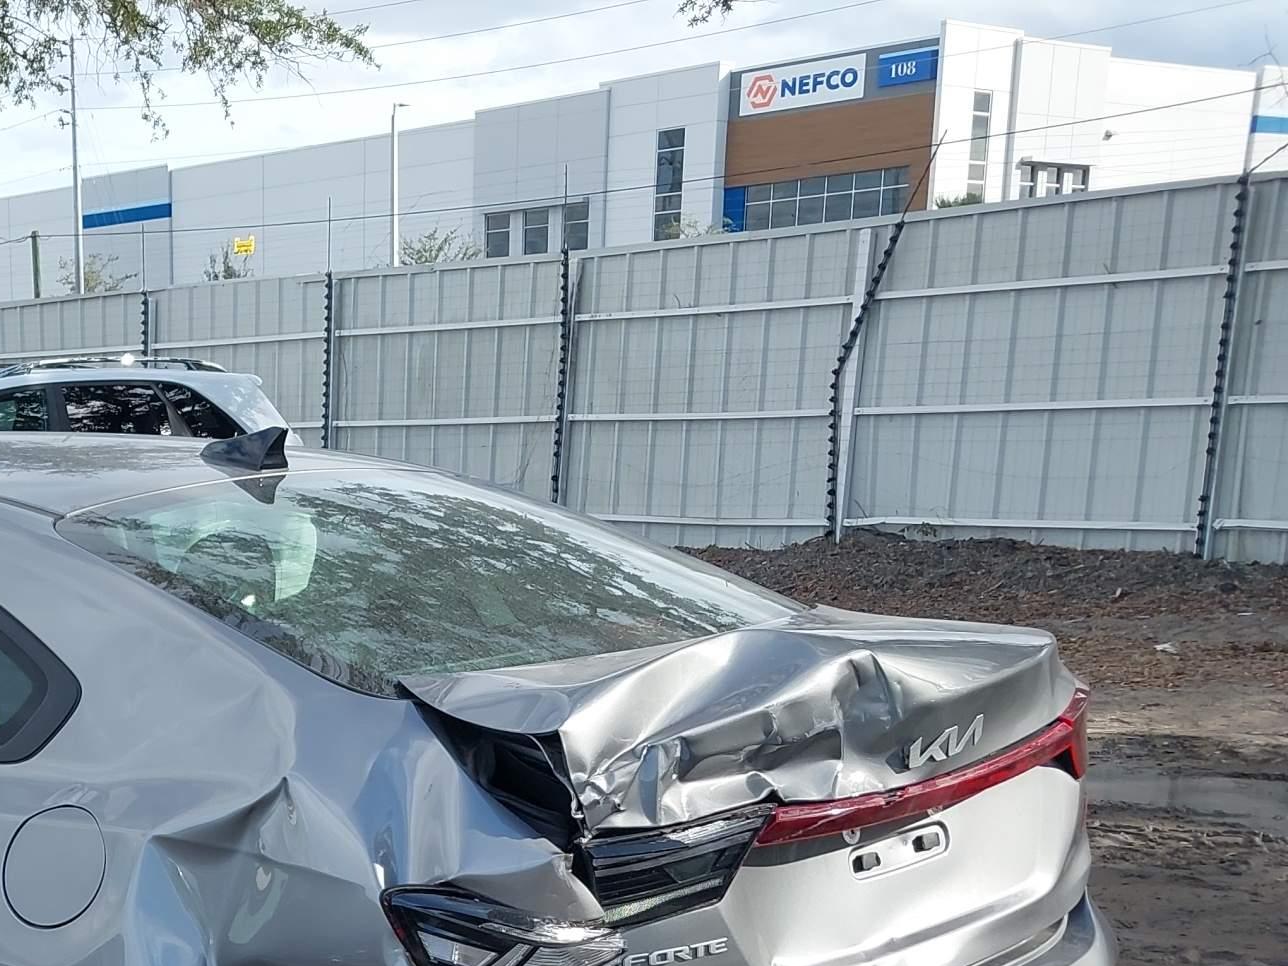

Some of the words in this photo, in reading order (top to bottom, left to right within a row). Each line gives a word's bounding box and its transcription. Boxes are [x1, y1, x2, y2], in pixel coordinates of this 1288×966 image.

[780, 68, 858, 98] NEFCO
[889, 61, 916, 78] 108
[909, 713, 984, 769] KIA
